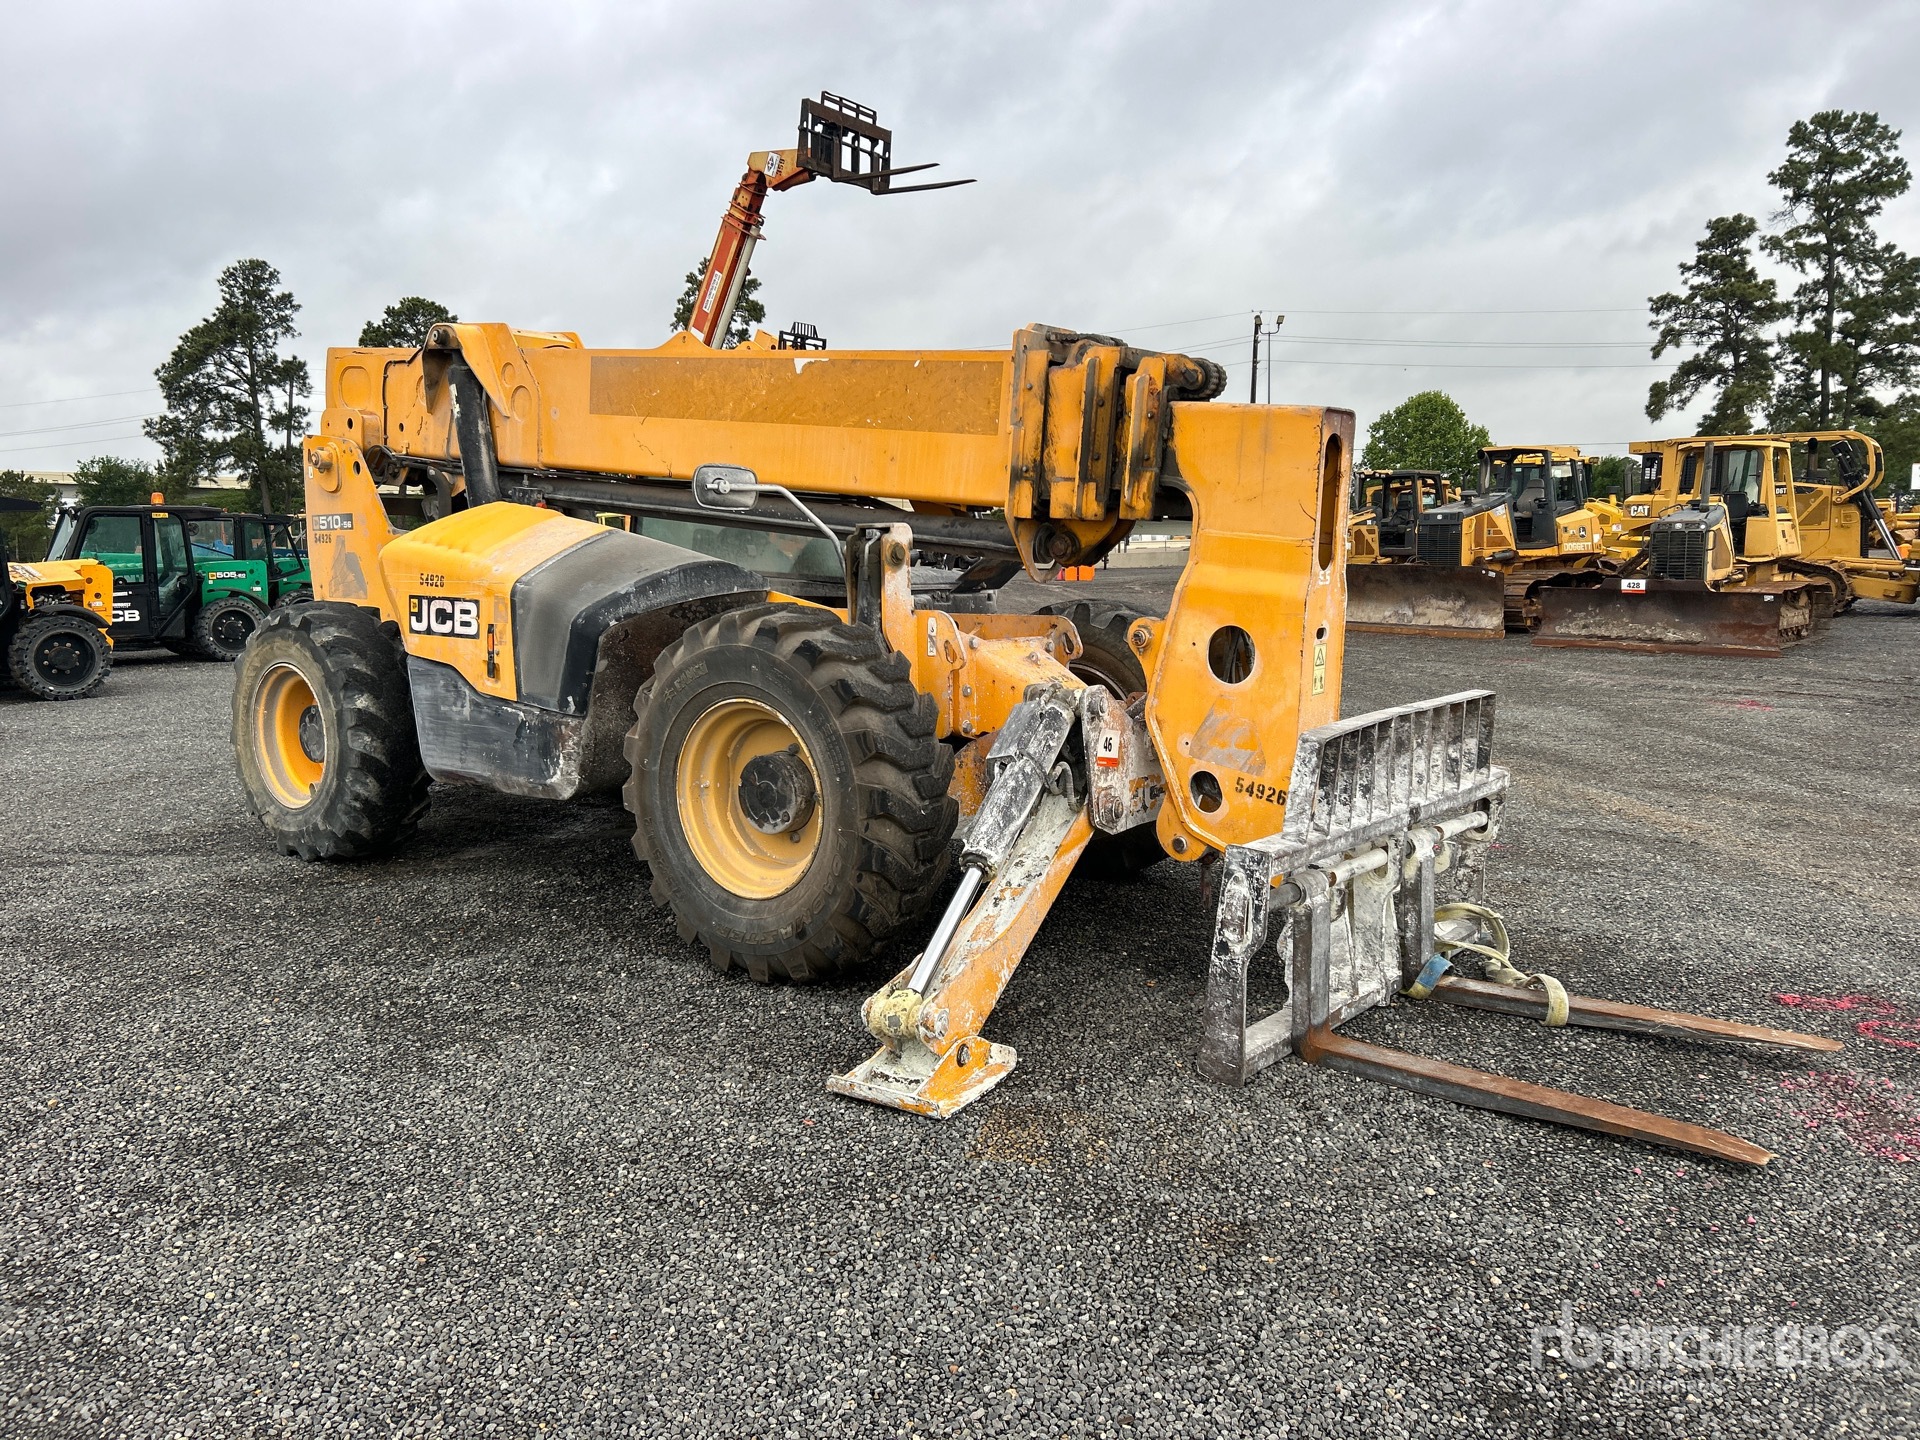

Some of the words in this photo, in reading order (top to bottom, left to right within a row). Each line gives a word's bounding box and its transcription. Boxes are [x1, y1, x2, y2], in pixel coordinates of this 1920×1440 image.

[1630, 505, 1650, 517] CAT
[314, 533, 332, 544] 54926
[1563, 541, 1592, 551] DOGGETT
[419, 572, 445, 588] 54926
[410, 598, 479, 636] JCB
[1103, 736, 1113, 753] 46
[1234, 776, 1287, 806] 54926
